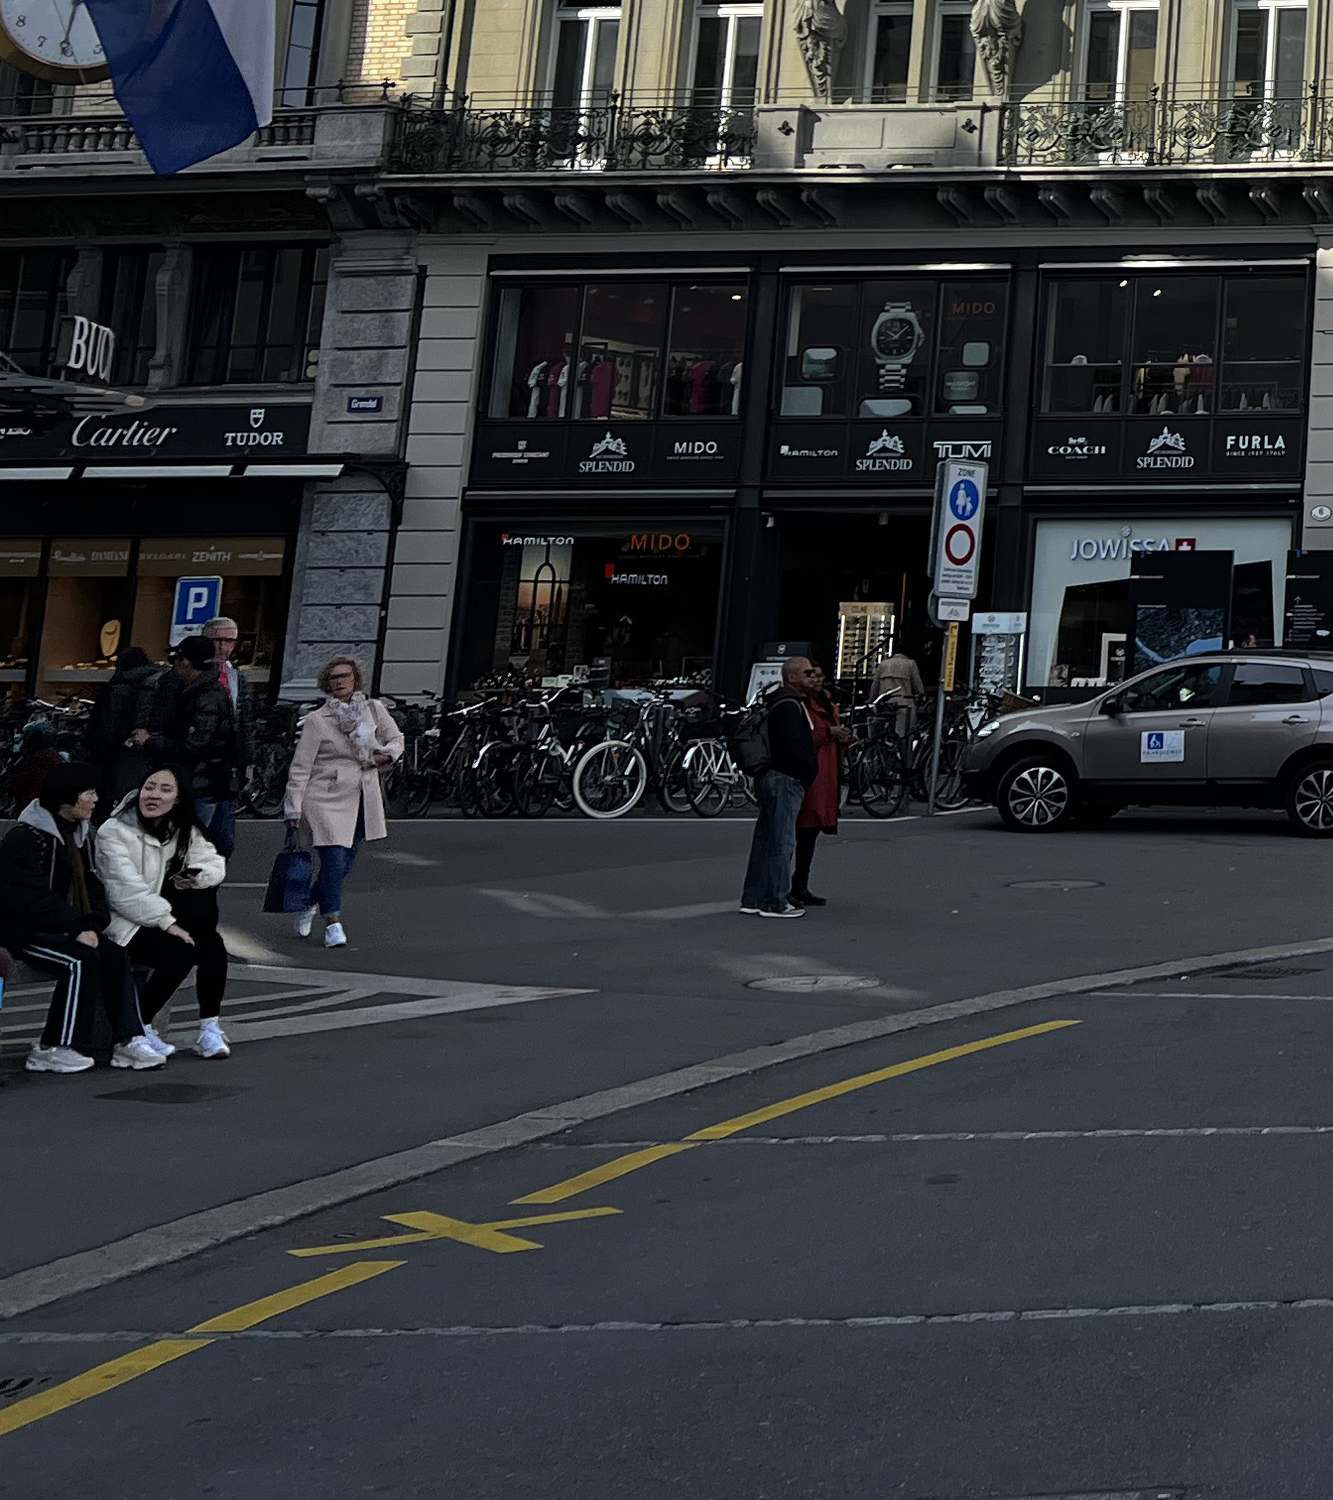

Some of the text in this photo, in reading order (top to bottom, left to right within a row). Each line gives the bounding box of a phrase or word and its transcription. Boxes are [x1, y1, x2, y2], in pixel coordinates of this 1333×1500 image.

[952, 301, 996, 314] MIDO
[71, 414, 178, 447] Cartier
[223, 432, 285, 446] TUDOR
[1226, 434, 1286, 450] FURLA
[674, 441, 718, 454] MIDO
[933, 440, 992, 458] TUMI
[1047, 445, 1106, 455] COACH
[578, 460, 635, 473] SPLENDID
[855, 459, 913, 471] SPLENDID
[1136, 456, 1194, 469] SPLENDID
[503, 535, 574, 546] HAMILTON
[630, 533, 692, 551] MIDO
[191, 551, 231, 563] ZENITH
[610, 573, 668, 585] HAMILTON
[186, 586, 209, 620] P
